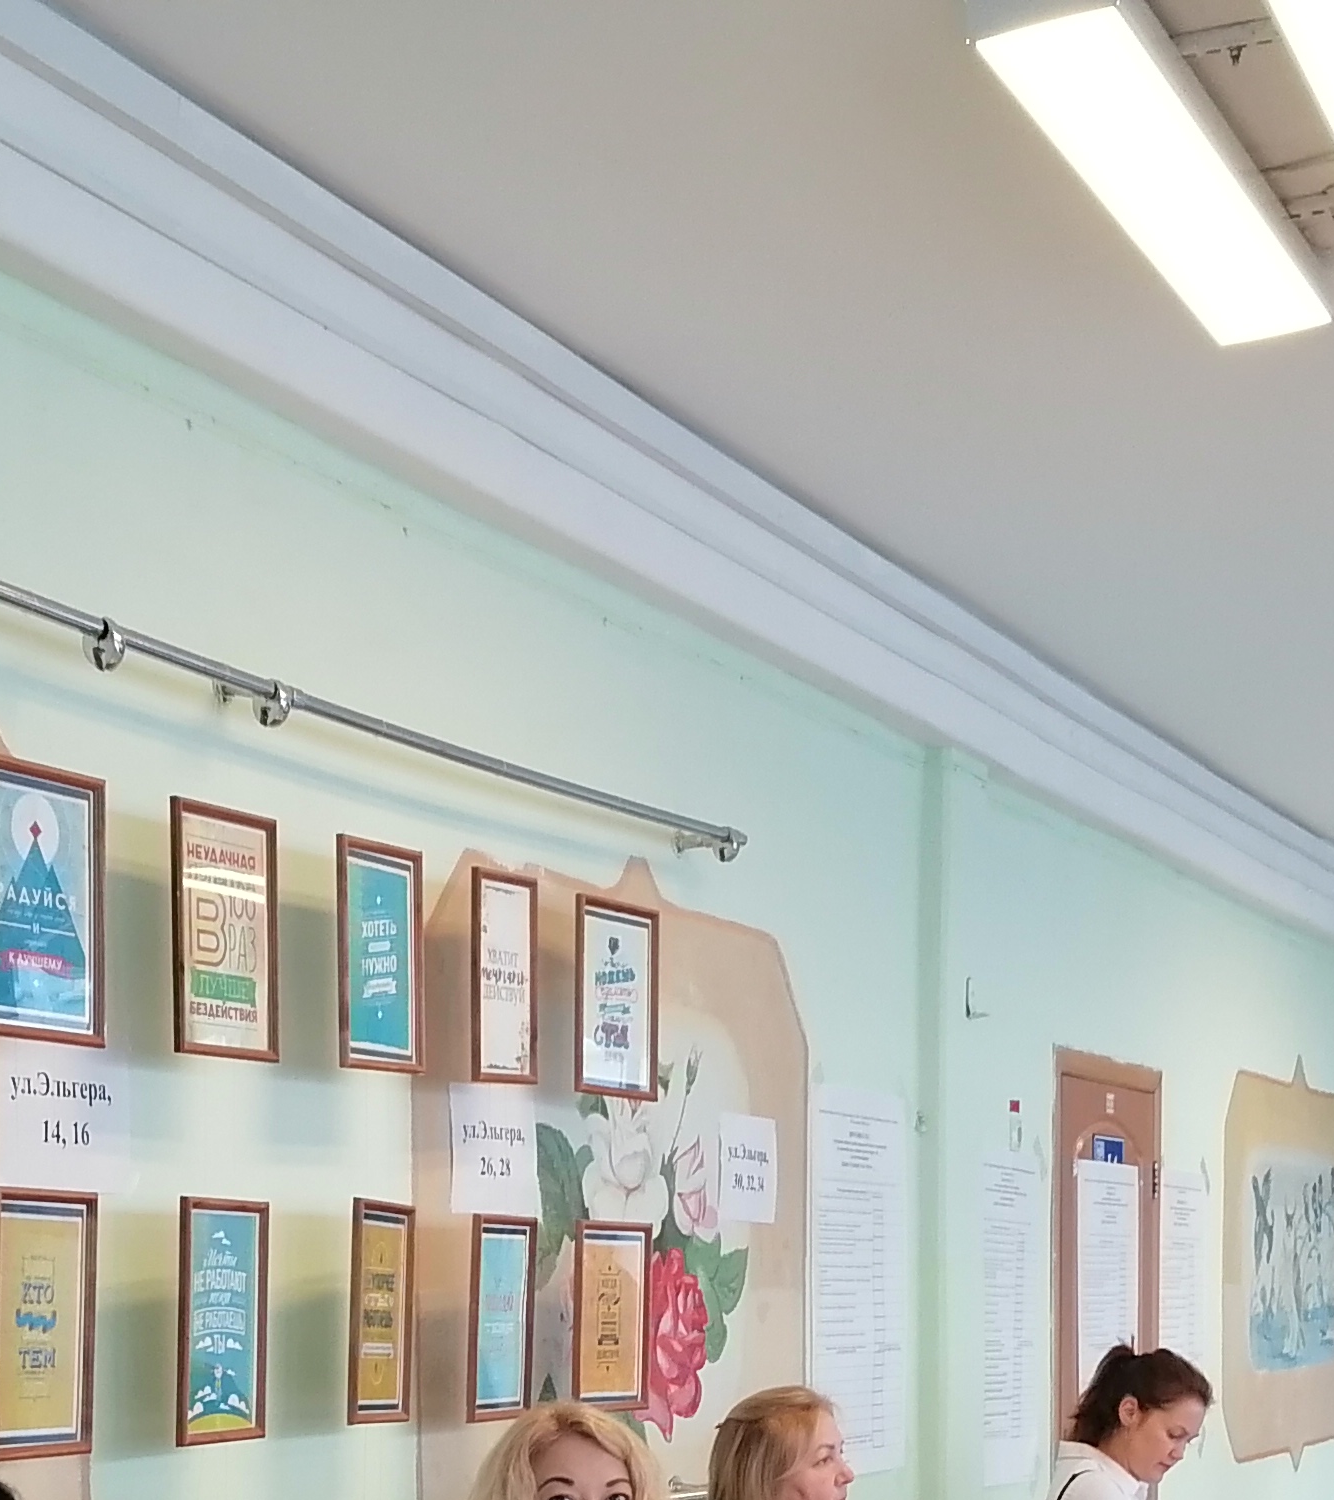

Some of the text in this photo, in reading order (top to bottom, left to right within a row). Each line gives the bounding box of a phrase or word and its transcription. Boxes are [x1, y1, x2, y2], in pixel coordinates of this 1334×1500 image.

[186, 841, 256, 870] НЕУДАЧНАЯ
[32, 922, 40, 934] И
[188, 887, 227, 966] В
[362, 919, 397, 939] ХОТЕТЬ
[228, 923, 257, 973] РАЗ
[487, 948, 518, 968] ХВАТИТ
[8, 952, 64, 971] К ЛУЧШЕМУ
[362, 955, 397, 976] НУЖНО
[198, 973, 250, 1001] ЛУЧШЕ
[483, 984, 526, 1006] ДЕЙСТВУЙ
[189, 1000, 258, 1023] БЕЗДЕЙСТВИЯ
[10, 1072, 112, 1107] ул.Эльгера,
[43, 1120, 90, 1149] 14, 16
[463, 1120, 525, 1146] ул.Эльгера,
[480, 1157, 511, 1180] 26, 28
[194, 1269, 247, 1293] НЕ РАБОТАЮТ
[21, 1282, 55, 1304] КТО
[214, 1335, 226, 1354] ТЫ
[19, 1348, 56, 1370] ТЕМ
